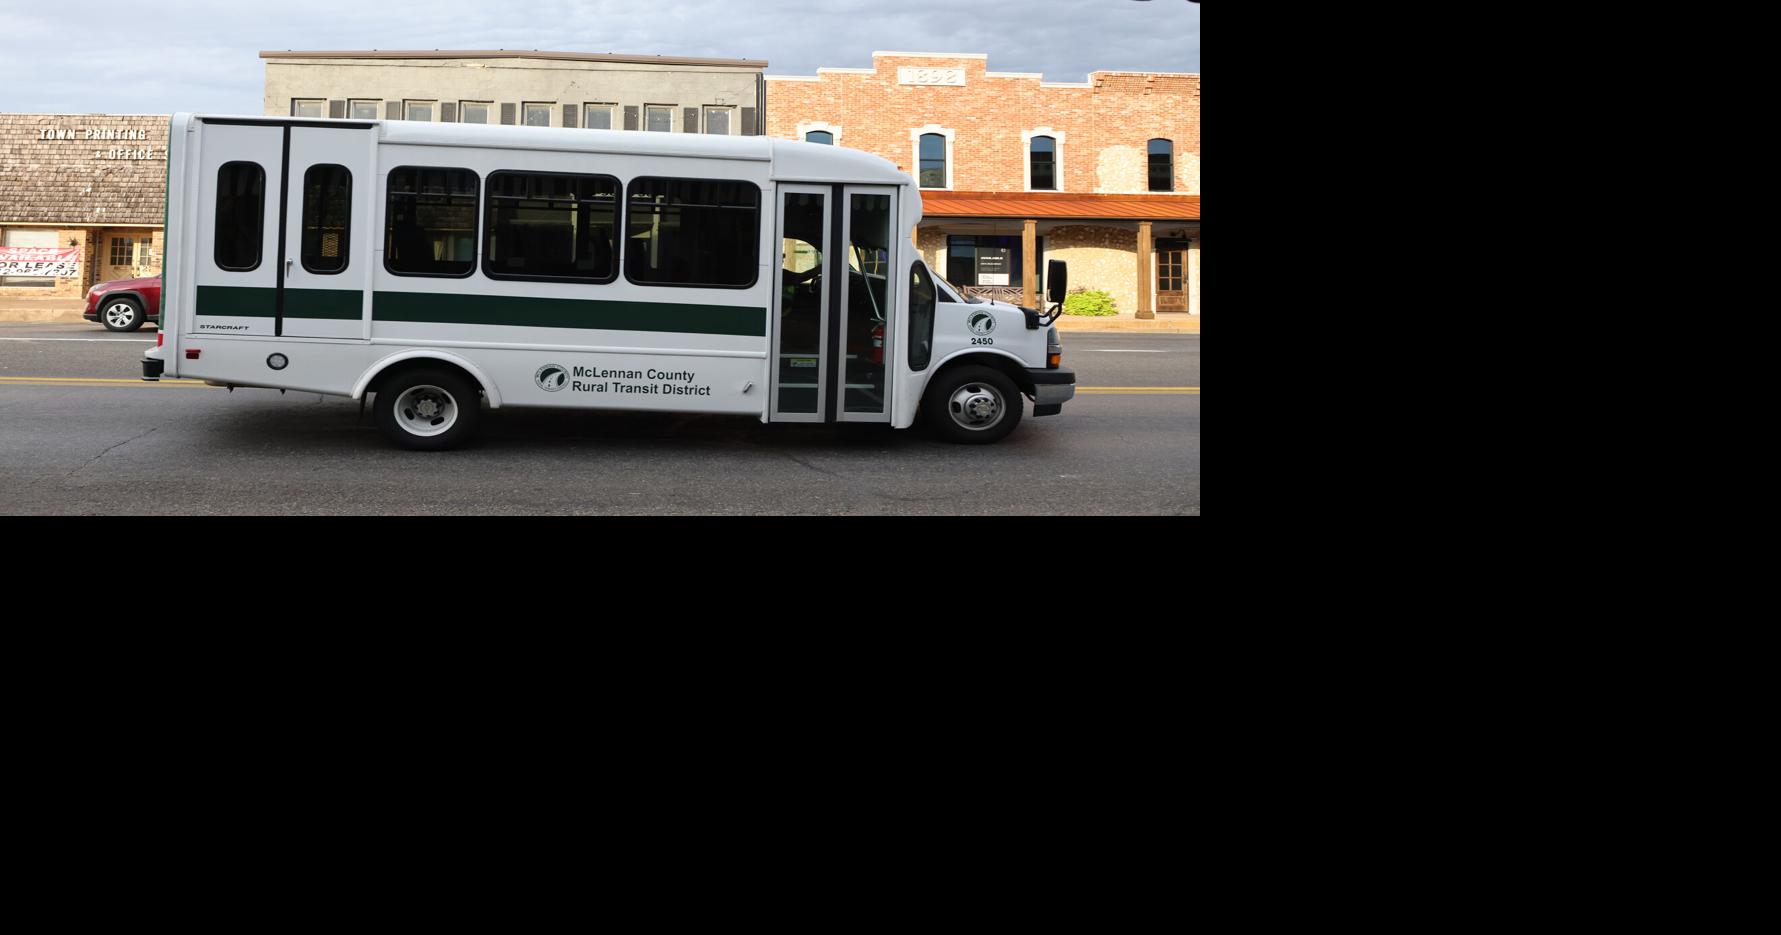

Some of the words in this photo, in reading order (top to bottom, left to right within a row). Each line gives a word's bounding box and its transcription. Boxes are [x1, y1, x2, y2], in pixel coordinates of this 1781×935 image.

[40, 129, 76, 140] TOWN
[85, 129, 146, 140] PRINTING
[108, 149, 153, 160] OFFICE
[971, 337, 994, 345] 2450
[572, 366, 643, 380] McLennan
[646, 368, 695, 384] County
[572, 381, 608, 393] Rural
[612, 382, 659, 395] Transit
[662, 384, 711, 396] District
